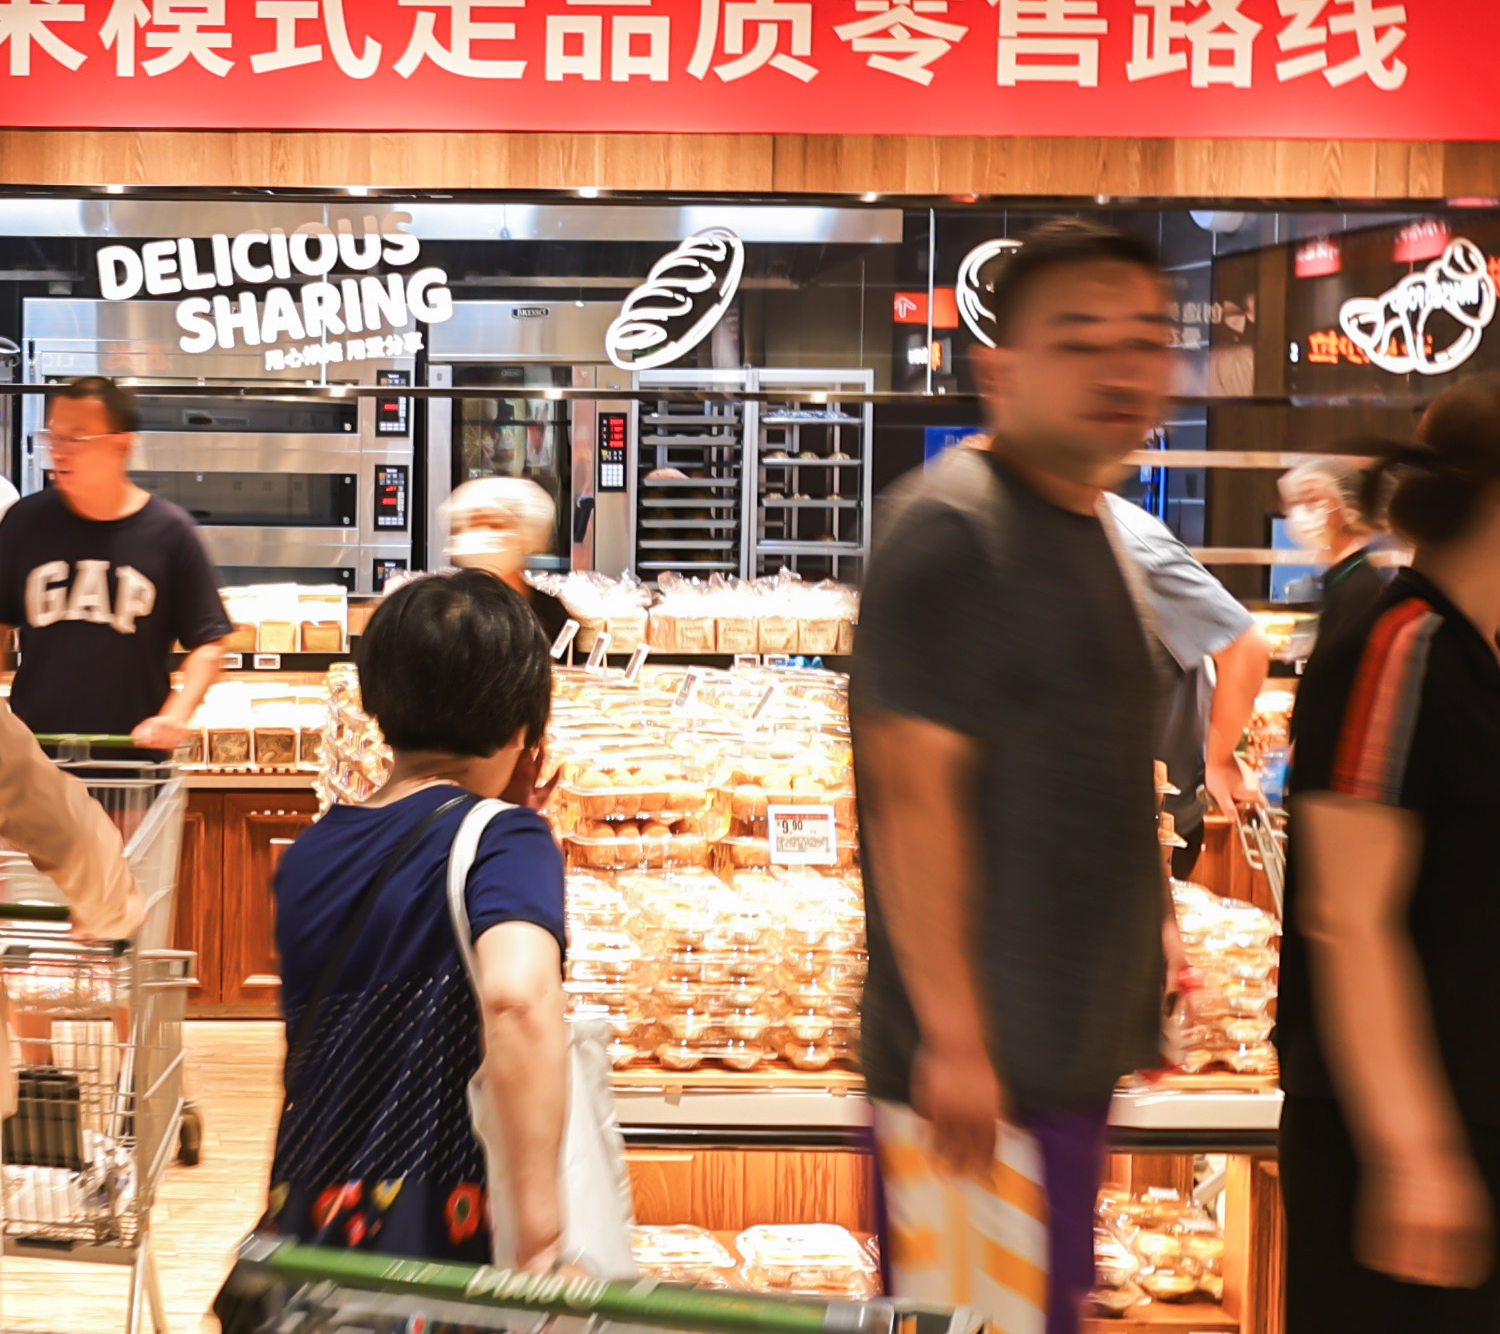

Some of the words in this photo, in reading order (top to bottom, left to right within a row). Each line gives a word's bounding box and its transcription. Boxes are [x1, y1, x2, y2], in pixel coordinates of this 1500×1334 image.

[96, 210, 421, 301] DELICIOUS
[175, 266, 454, 354] SHARING
[24, 558, 157, 634] GAP
